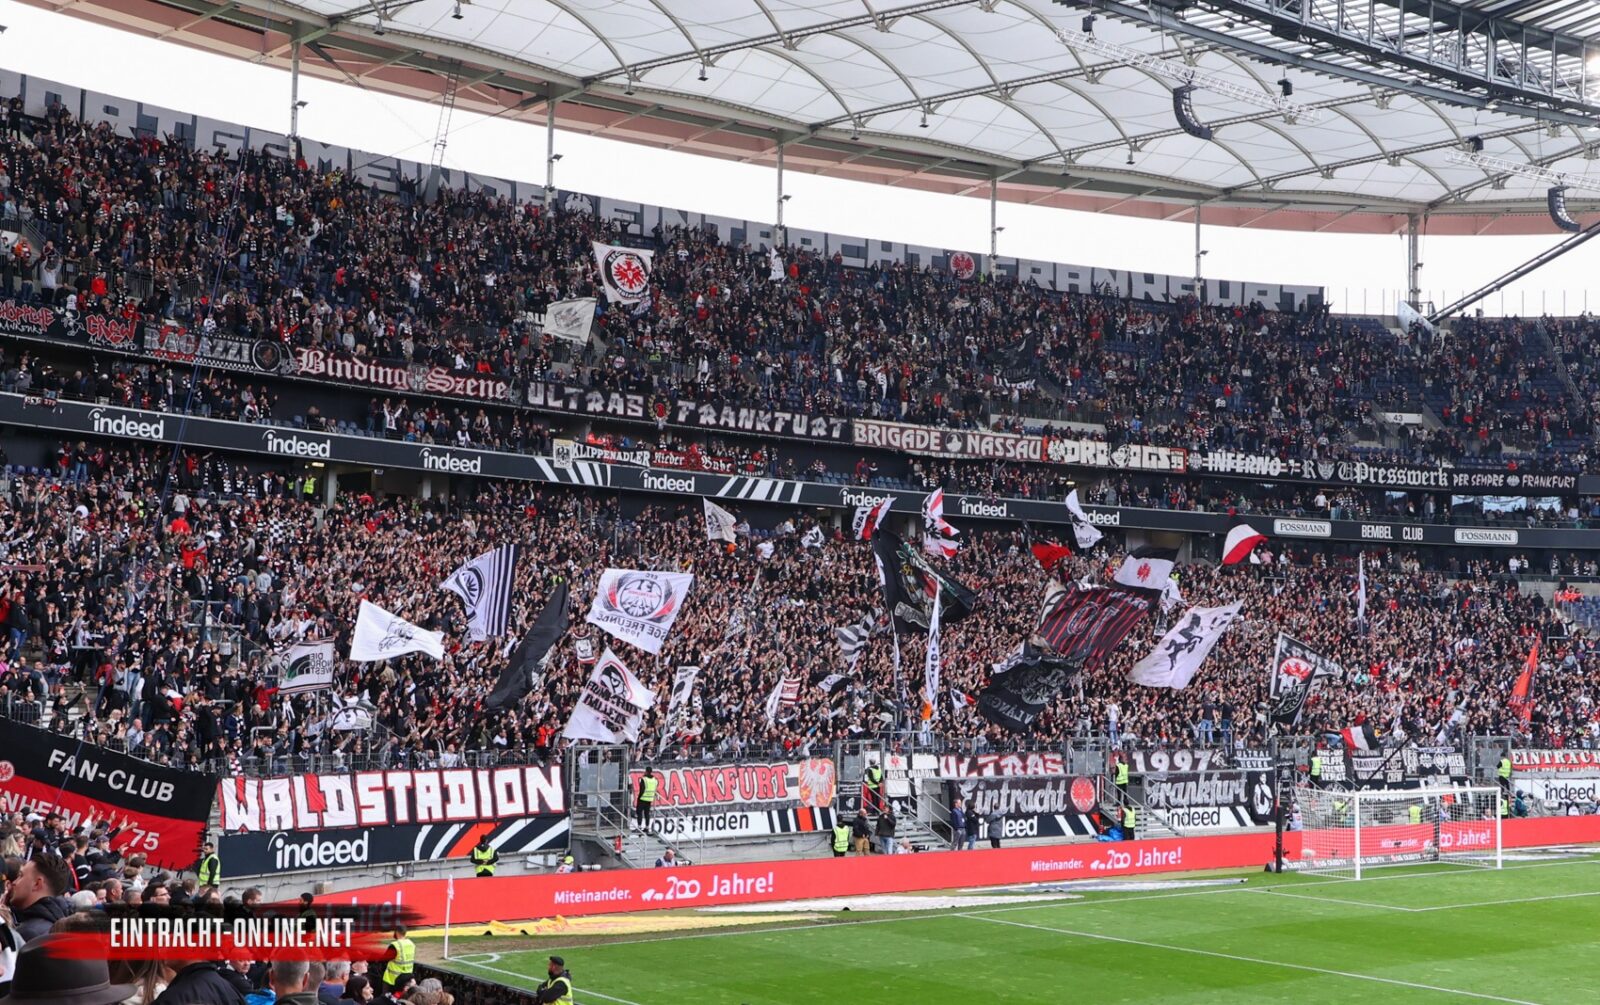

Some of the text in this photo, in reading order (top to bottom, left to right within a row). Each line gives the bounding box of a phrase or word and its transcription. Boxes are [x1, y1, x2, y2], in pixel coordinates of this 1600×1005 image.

[528, 381, 848, 439] ULTRAS FRANKFURT
[93, 412, 165, 440] indeed
[268, 433, 331, 459] indeed
[854, 423, 1042, 460] BRIGADE NASSAU
[423, 451, 481, 476] indeed
[572, 443, 651, 467] KLIPPENADLER
[1207, 451, 1282, 477] INFERNO
[643, 472, 696, 493] indeed
[1521, 475, 1576, 489] FRANKFURT
[961, 500, 1008, 518] indeed
[1279, 521, 1327, 534] POSSMANN
[1361, 524, 1424, 541] BEMBEL CLUB
[1460, 531, 1512, 542] POSSMANN
[939, 752, 1066, 778] ULTRAS
[1131, 750, 1214, 773] 1997
[48, 748, 176, 803] FAN-CLUB
[220, 764, 566, 833] WALDSTADION
[1545, 782, 1596, 801] indeed
[650, 816, 685, 834] obs
[129, 828, 160, 851] 75
[275, 830, 370, 871] indeed
[1031, 858, 1084, 872] Miteinander.
[1135, 846, 1182, 867] Jahre!
[554, 886, 632, 905] Miteinander.
[706, 871, 775, 897] Jahre!
